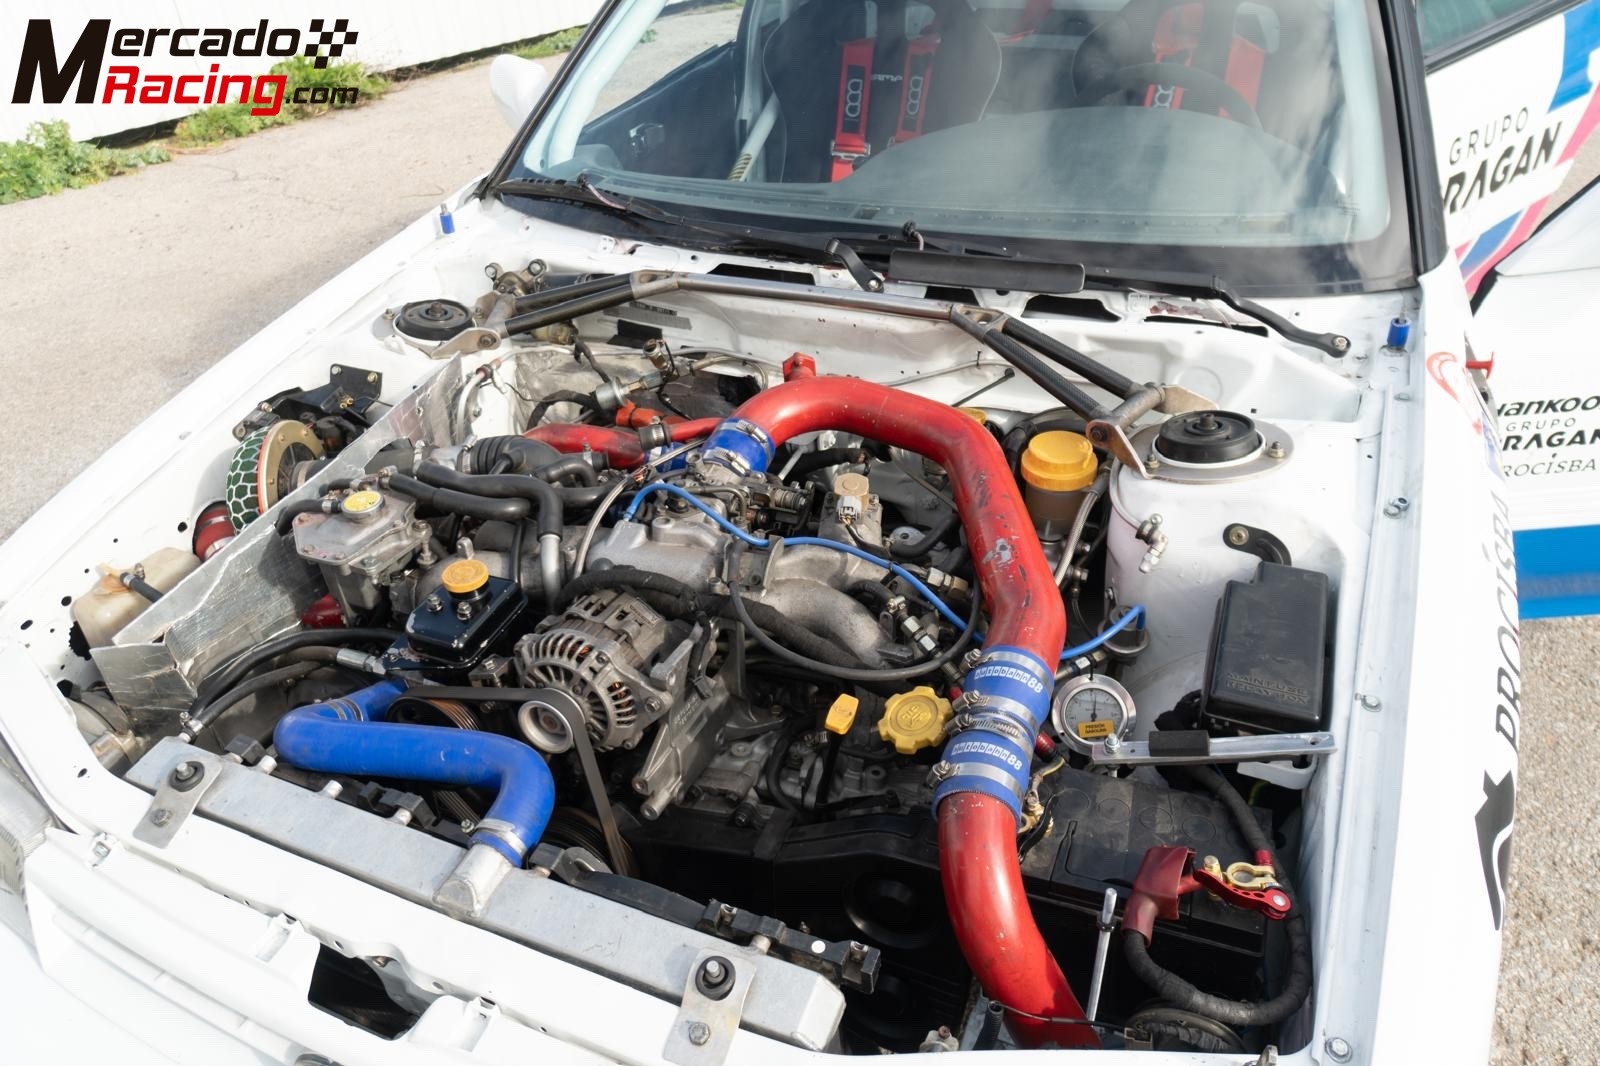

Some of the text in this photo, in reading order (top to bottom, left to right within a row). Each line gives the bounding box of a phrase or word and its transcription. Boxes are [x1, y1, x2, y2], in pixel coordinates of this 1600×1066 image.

[1449, 107, 1529, 166] GRUPO
[1443, 121, 1563, 215] RAGAN
[1497, 396, 1600, 416] ankoo
[1506, 417, 1576, 432] GRUPO
[1500, 429, 1600, 451] RAGA
[1503, 453, 1596, 478] ROCÍSBA
